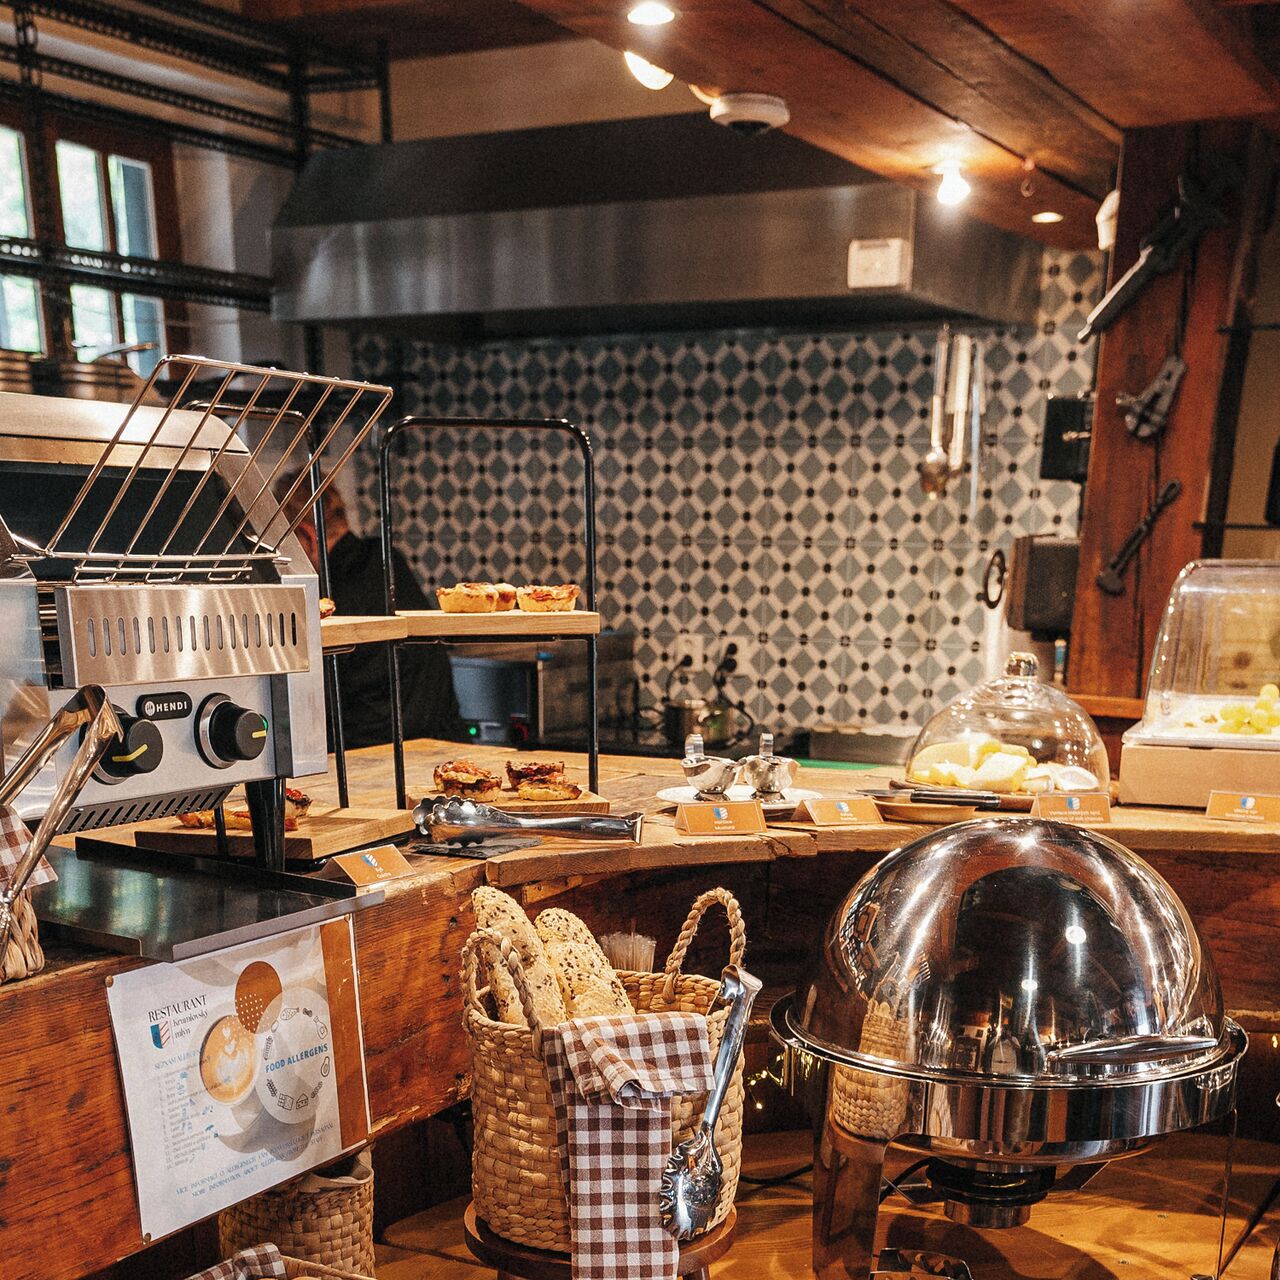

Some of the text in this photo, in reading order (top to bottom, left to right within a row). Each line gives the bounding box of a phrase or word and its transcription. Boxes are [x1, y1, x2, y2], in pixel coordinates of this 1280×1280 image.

[156, 701, 187, 712] HENDI
[148, 995, 207, 1022] RESTAURANT
[266, 1043, 328, 1073] FOOD ALLERGENS
